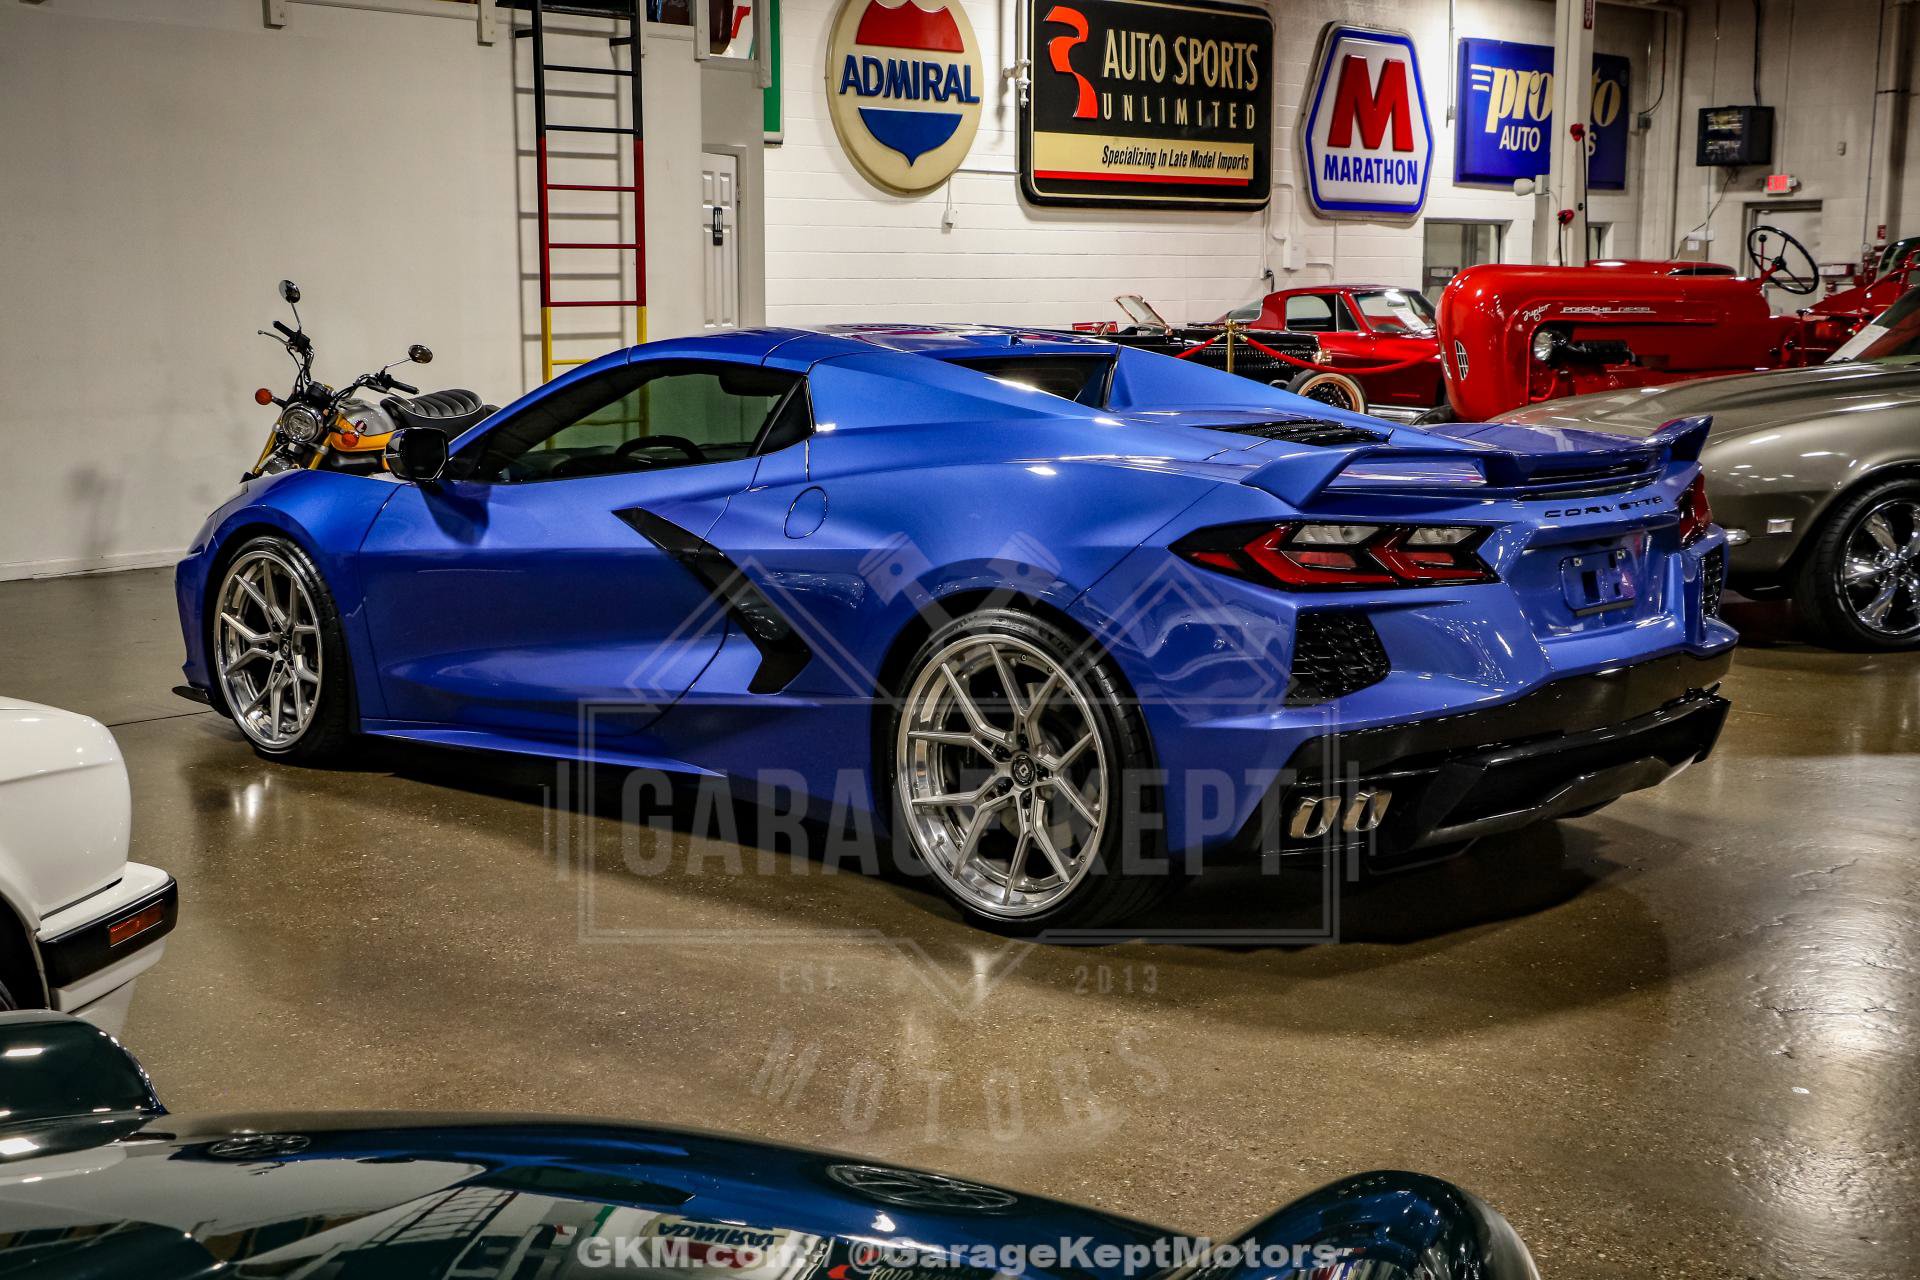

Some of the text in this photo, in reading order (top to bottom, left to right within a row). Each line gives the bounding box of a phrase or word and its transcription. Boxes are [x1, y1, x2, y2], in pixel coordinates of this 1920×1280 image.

[839, 54, 981, 104] ADMIRAL
[1103, 28, 1259, 92] AUTO SPORTS
[1102, 92, 1256, 130] UNLIMITED
[1327, 54, 1414, 152] M
[1484, 67, 1622, 134] proo
[1102, 144, 1250, 172] Specializing In Late Model Imports
[1499, 125, 1541, 153] AUTO
[1323, 154, 1418, 185] MARATHON
[1544, 495, 1663, 518] CORVETTE
